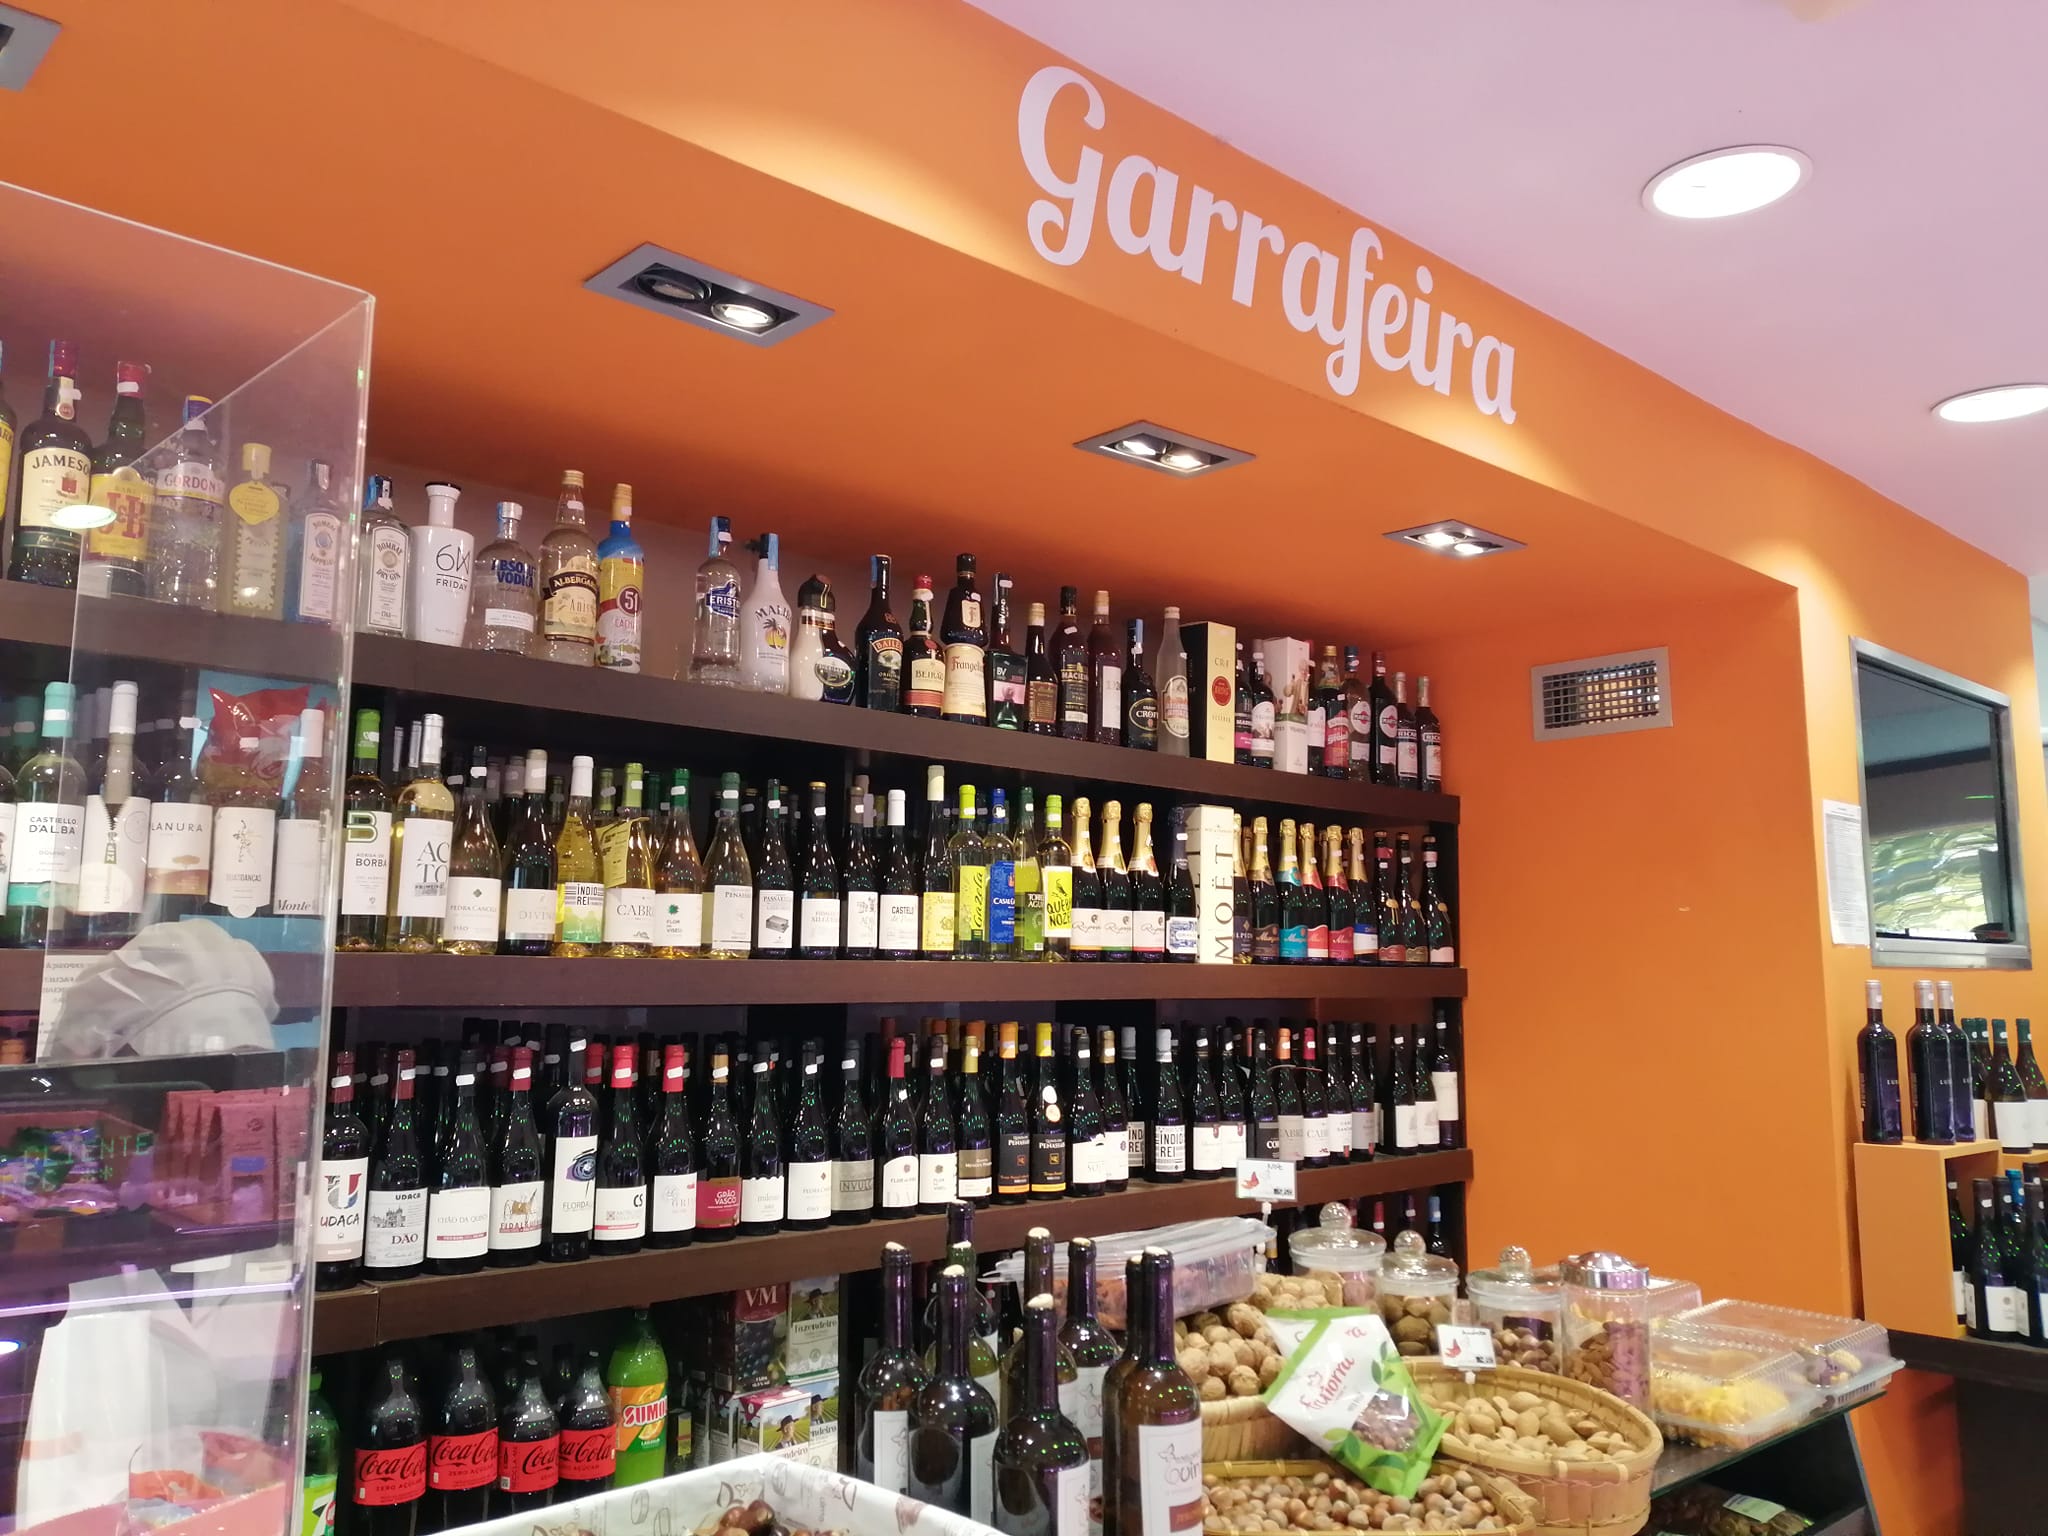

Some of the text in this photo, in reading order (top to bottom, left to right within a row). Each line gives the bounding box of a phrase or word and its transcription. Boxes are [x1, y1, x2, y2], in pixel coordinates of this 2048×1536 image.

[1018, 65, 1516, 424] Garrafeira
[436, 579, 467, 591] FRIDAY
[496, 571, 534, 589] VODKA
[625, 591, 638, 611] 51
[577, 896, 591, 906] REI
[1160, 1145, 1177, 1157] REI
[395, 1193, 421, 1201] UDACA
[320, 1213, 361, 1228] UDACA
[745, 1286, 778, 1307] VM
[376, 1484, 396, 1495] ZERO
